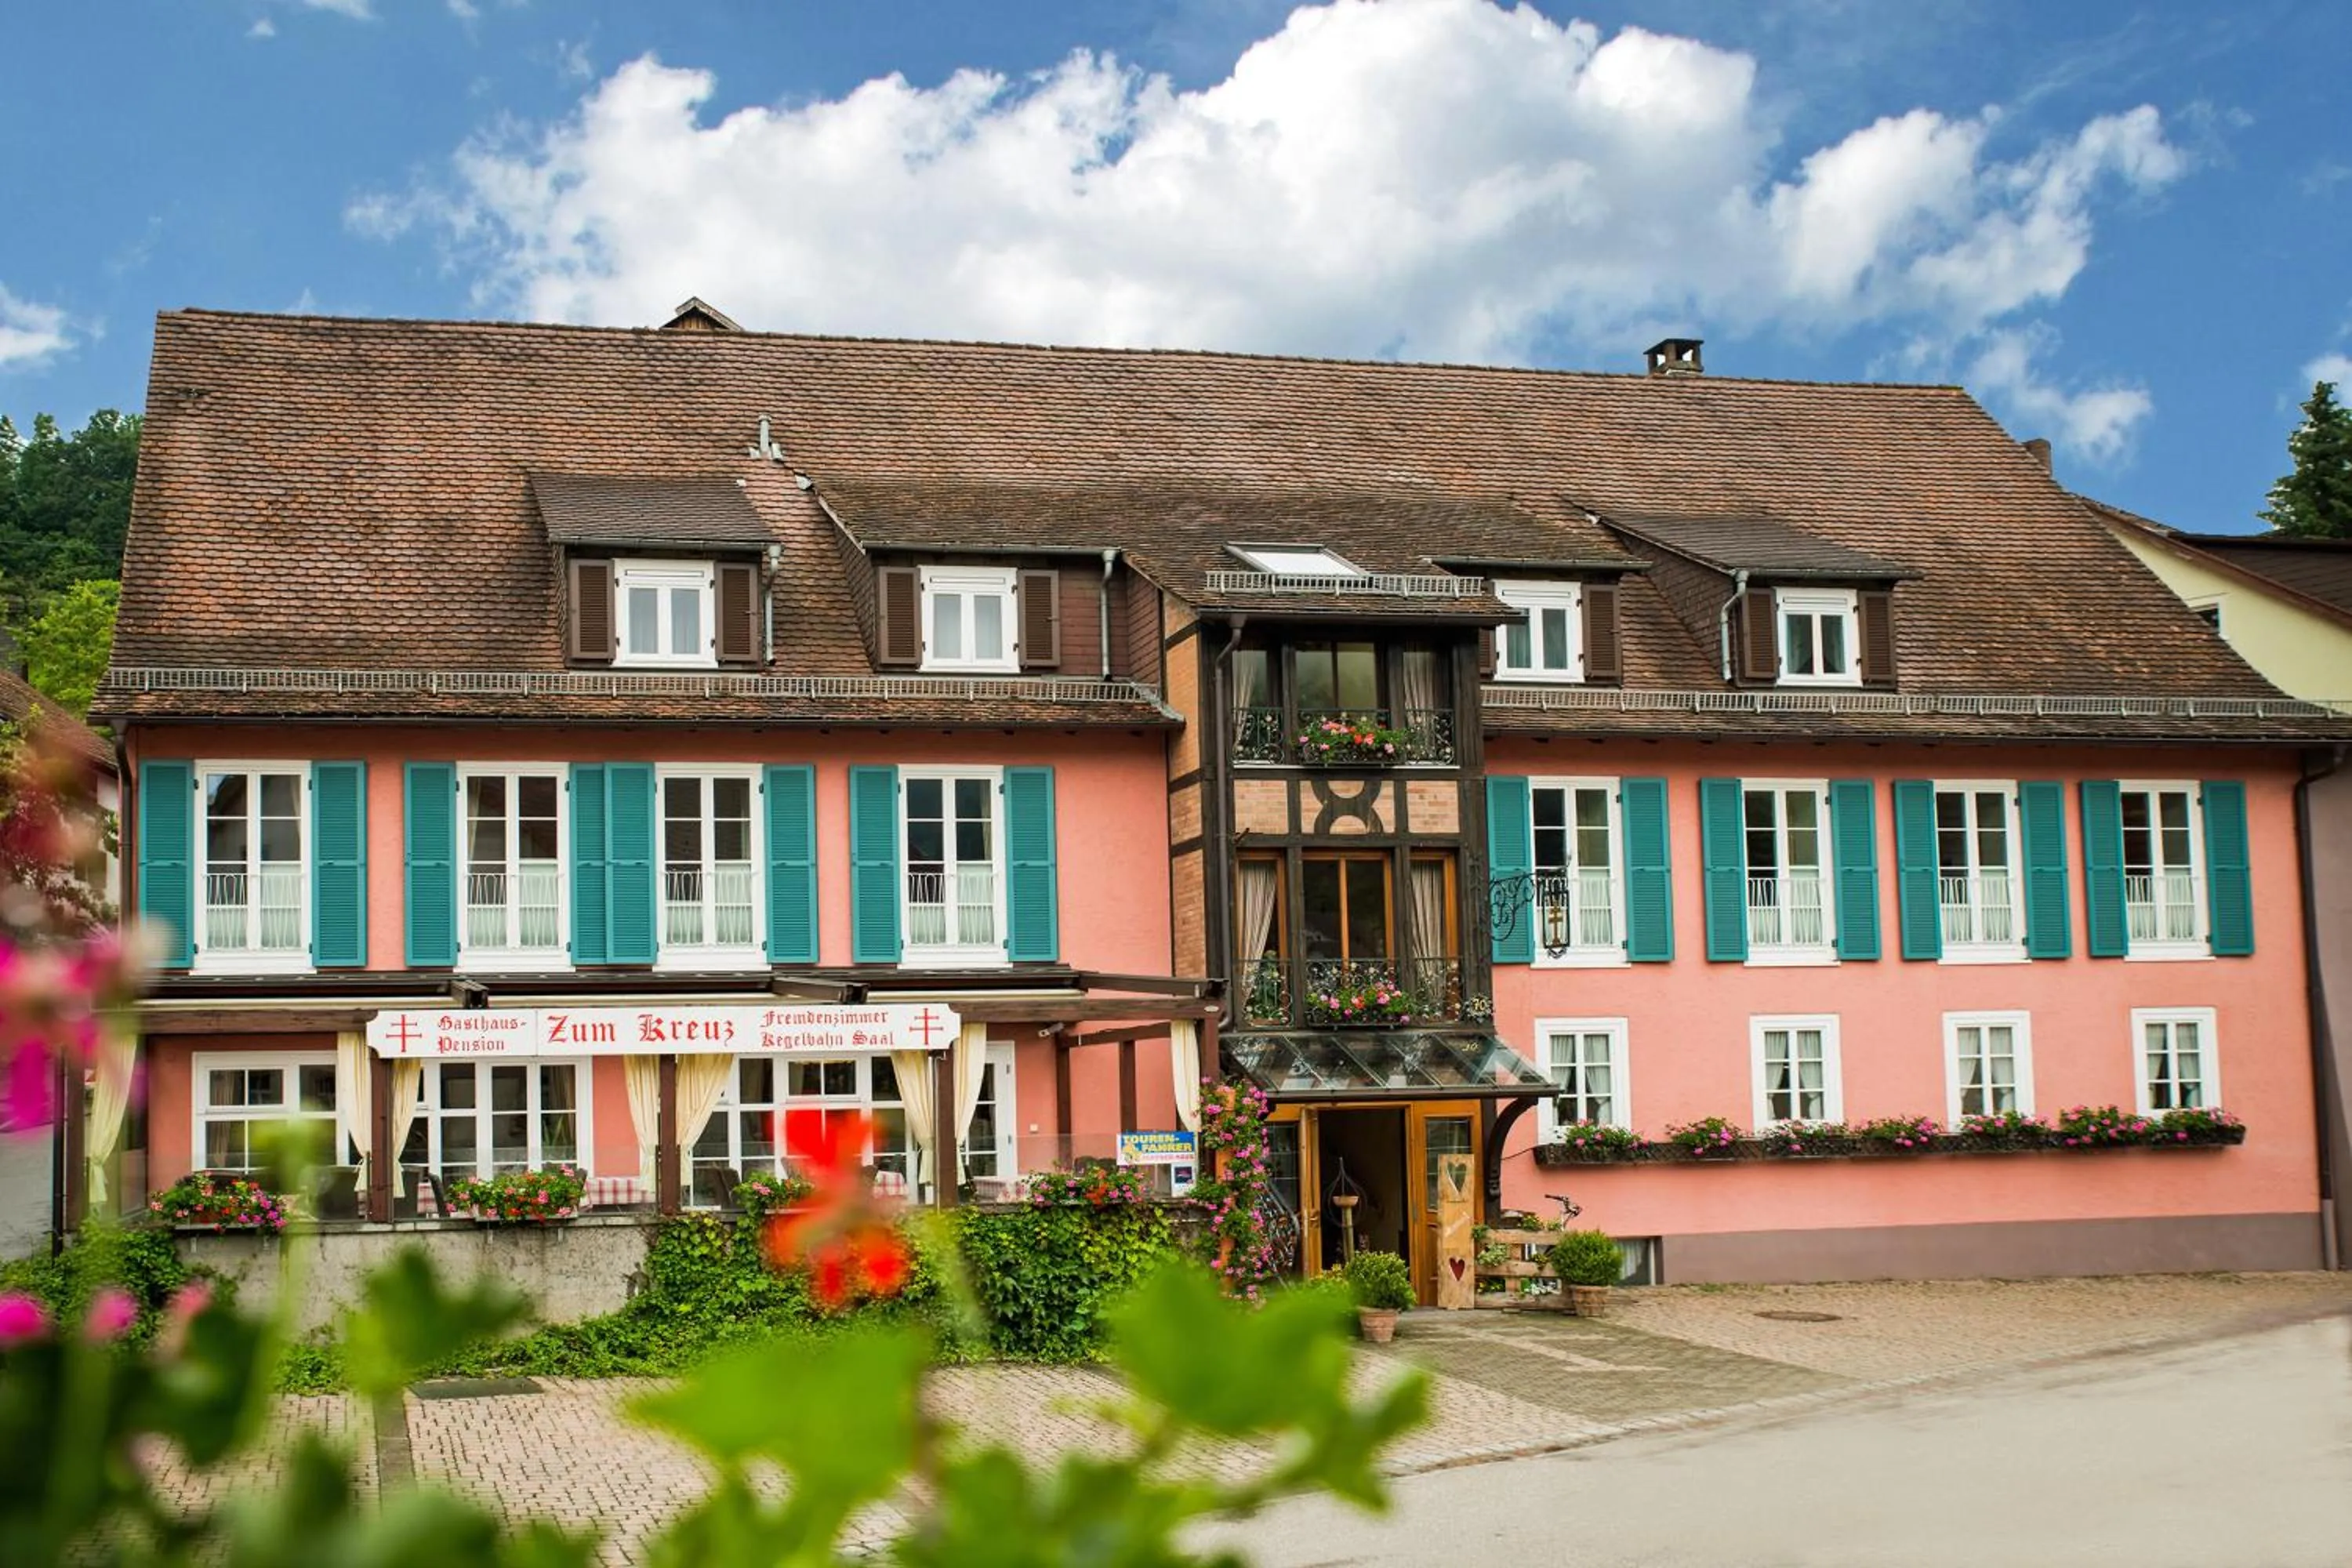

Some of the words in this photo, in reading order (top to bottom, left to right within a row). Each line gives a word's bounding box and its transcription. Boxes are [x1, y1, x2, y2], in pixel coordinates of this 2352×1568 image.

[1472, 998, 1486, 1011] 70
[437, 1015, 527, 1033] Gasthaus-
[760, 1009, 889, 1028] Fremdenzimmer
[546, 1014, 616, 1043] Zum
[637, 1014, 735, 1047] Kreuz
[760, 1030, 844, 1048] Kegelbahn
[851, 1029, 895, 1046] Saal
[437, 1035, 505, 1054] Pension
